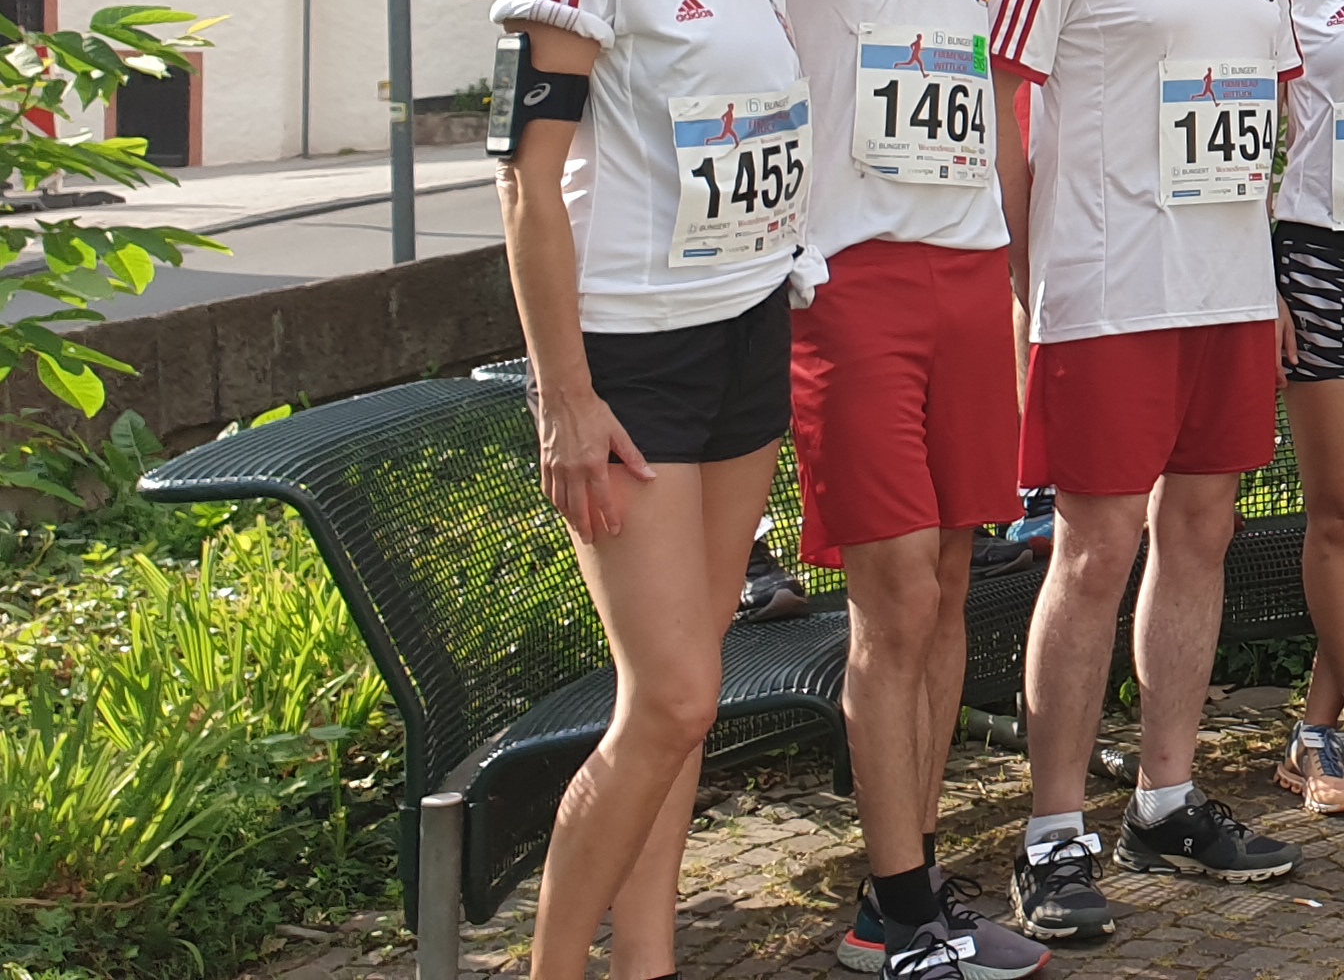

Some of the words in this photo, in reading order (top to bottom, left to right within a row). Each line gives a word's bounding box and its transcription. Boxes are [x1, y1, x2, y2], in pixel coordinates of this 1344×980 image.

[675, 8, 714, 22] adidas
[873, 79, 986, 144] 1464
[1174, 108, 1274, 164] 1454
[692, 140, 805, 219] 1455
